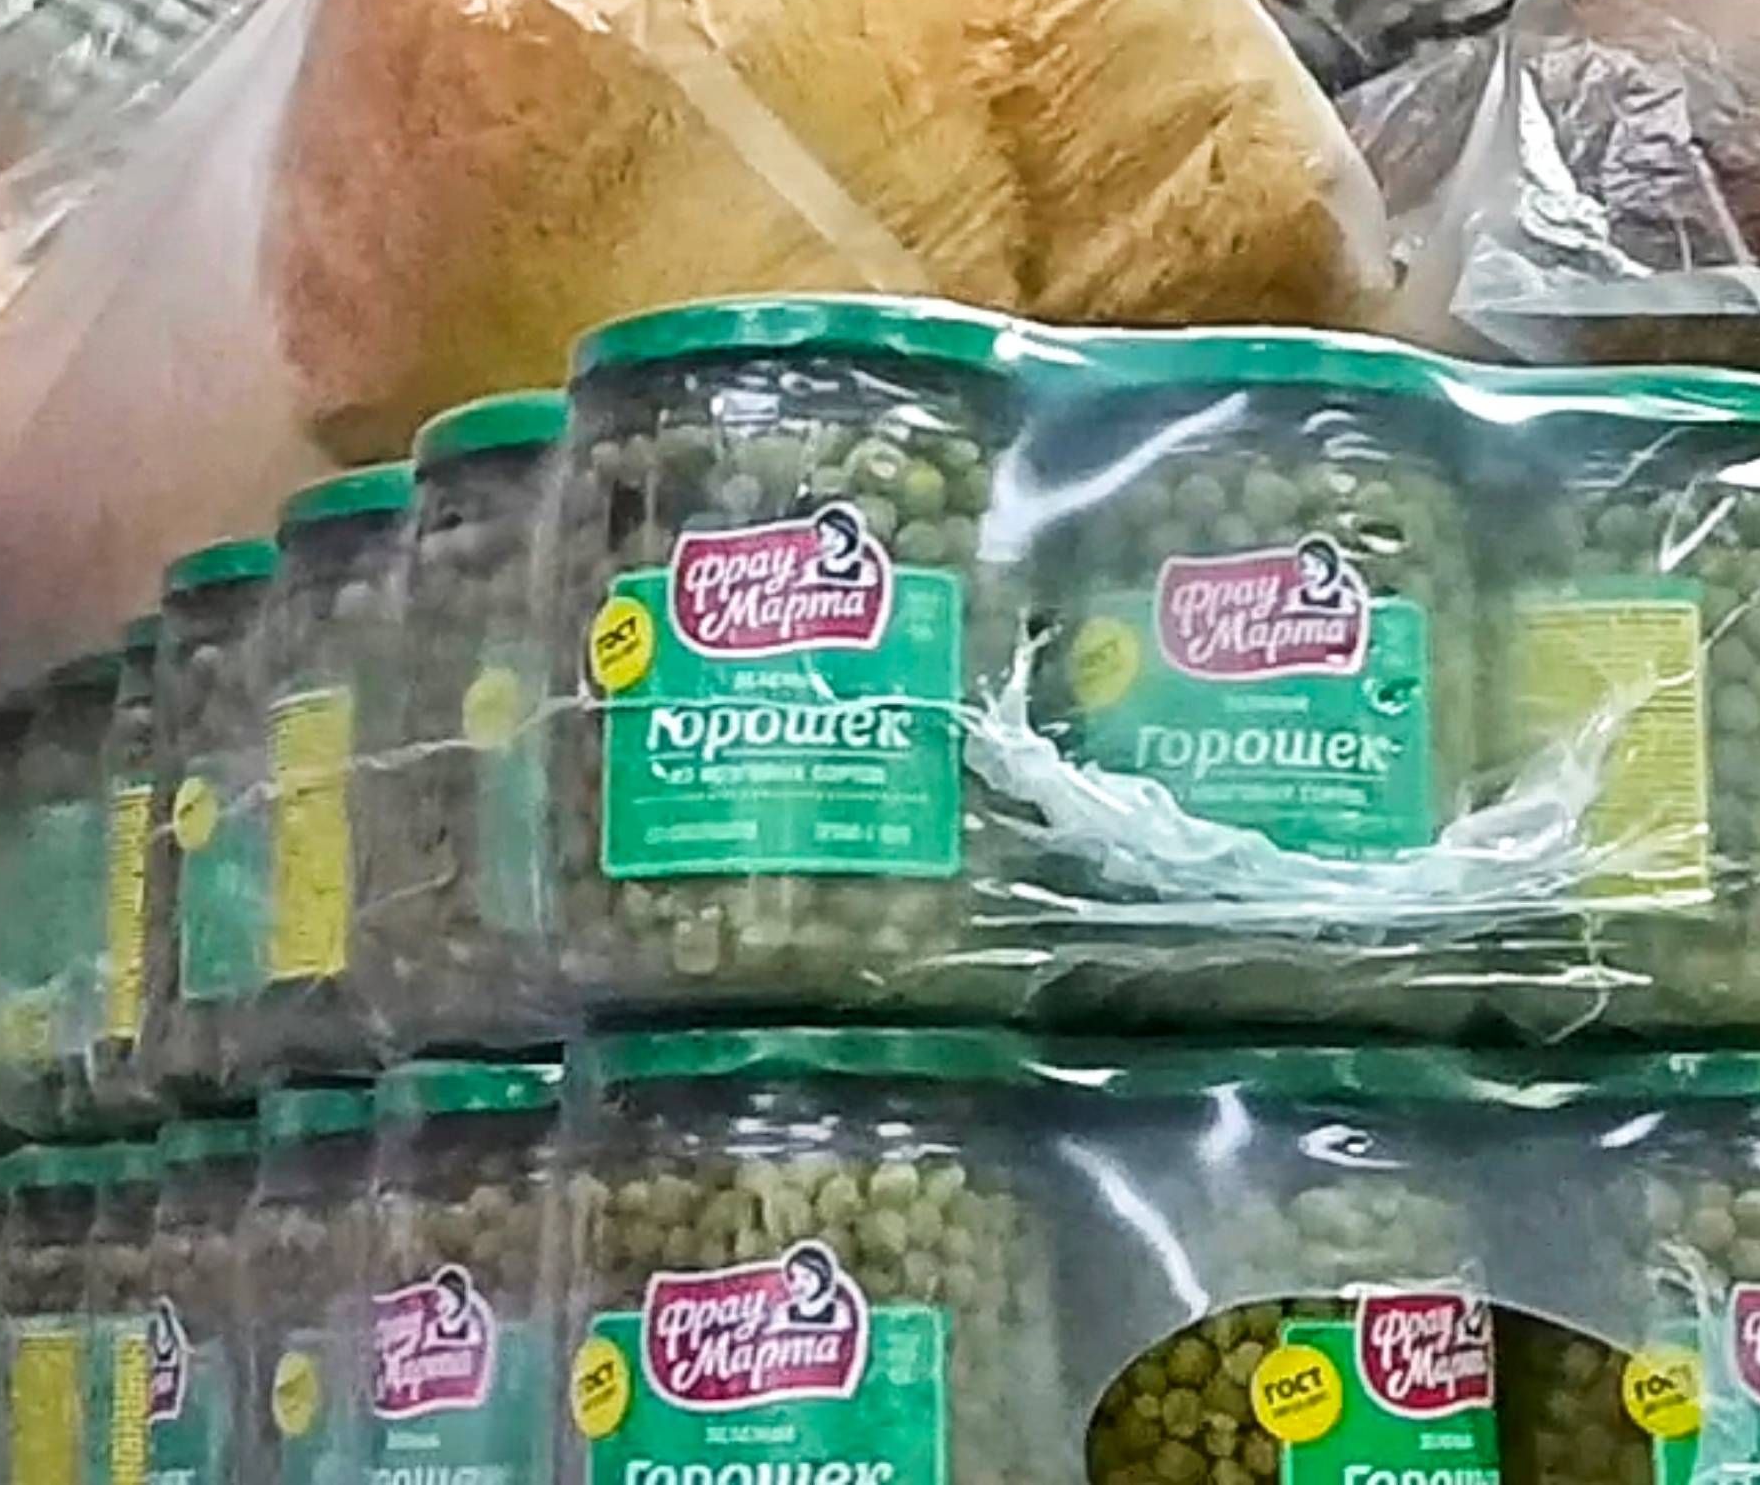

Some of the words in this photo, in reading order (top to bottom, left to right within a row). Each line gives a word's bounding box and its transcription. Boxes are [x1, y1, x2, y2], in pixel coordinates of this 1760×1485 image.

[684, 545, 799, 613] Фрау
[1172, 576, 1280, 637] Фрау
[699, 583, 865, 641] Марта
[1187, 611, 1347, 663] Марта
[657, 1290, 766, 1361] Фрау
[670, 1334, 840, 1391] Марта
[1264, 1366, 1323, 1404] ГОСТ
